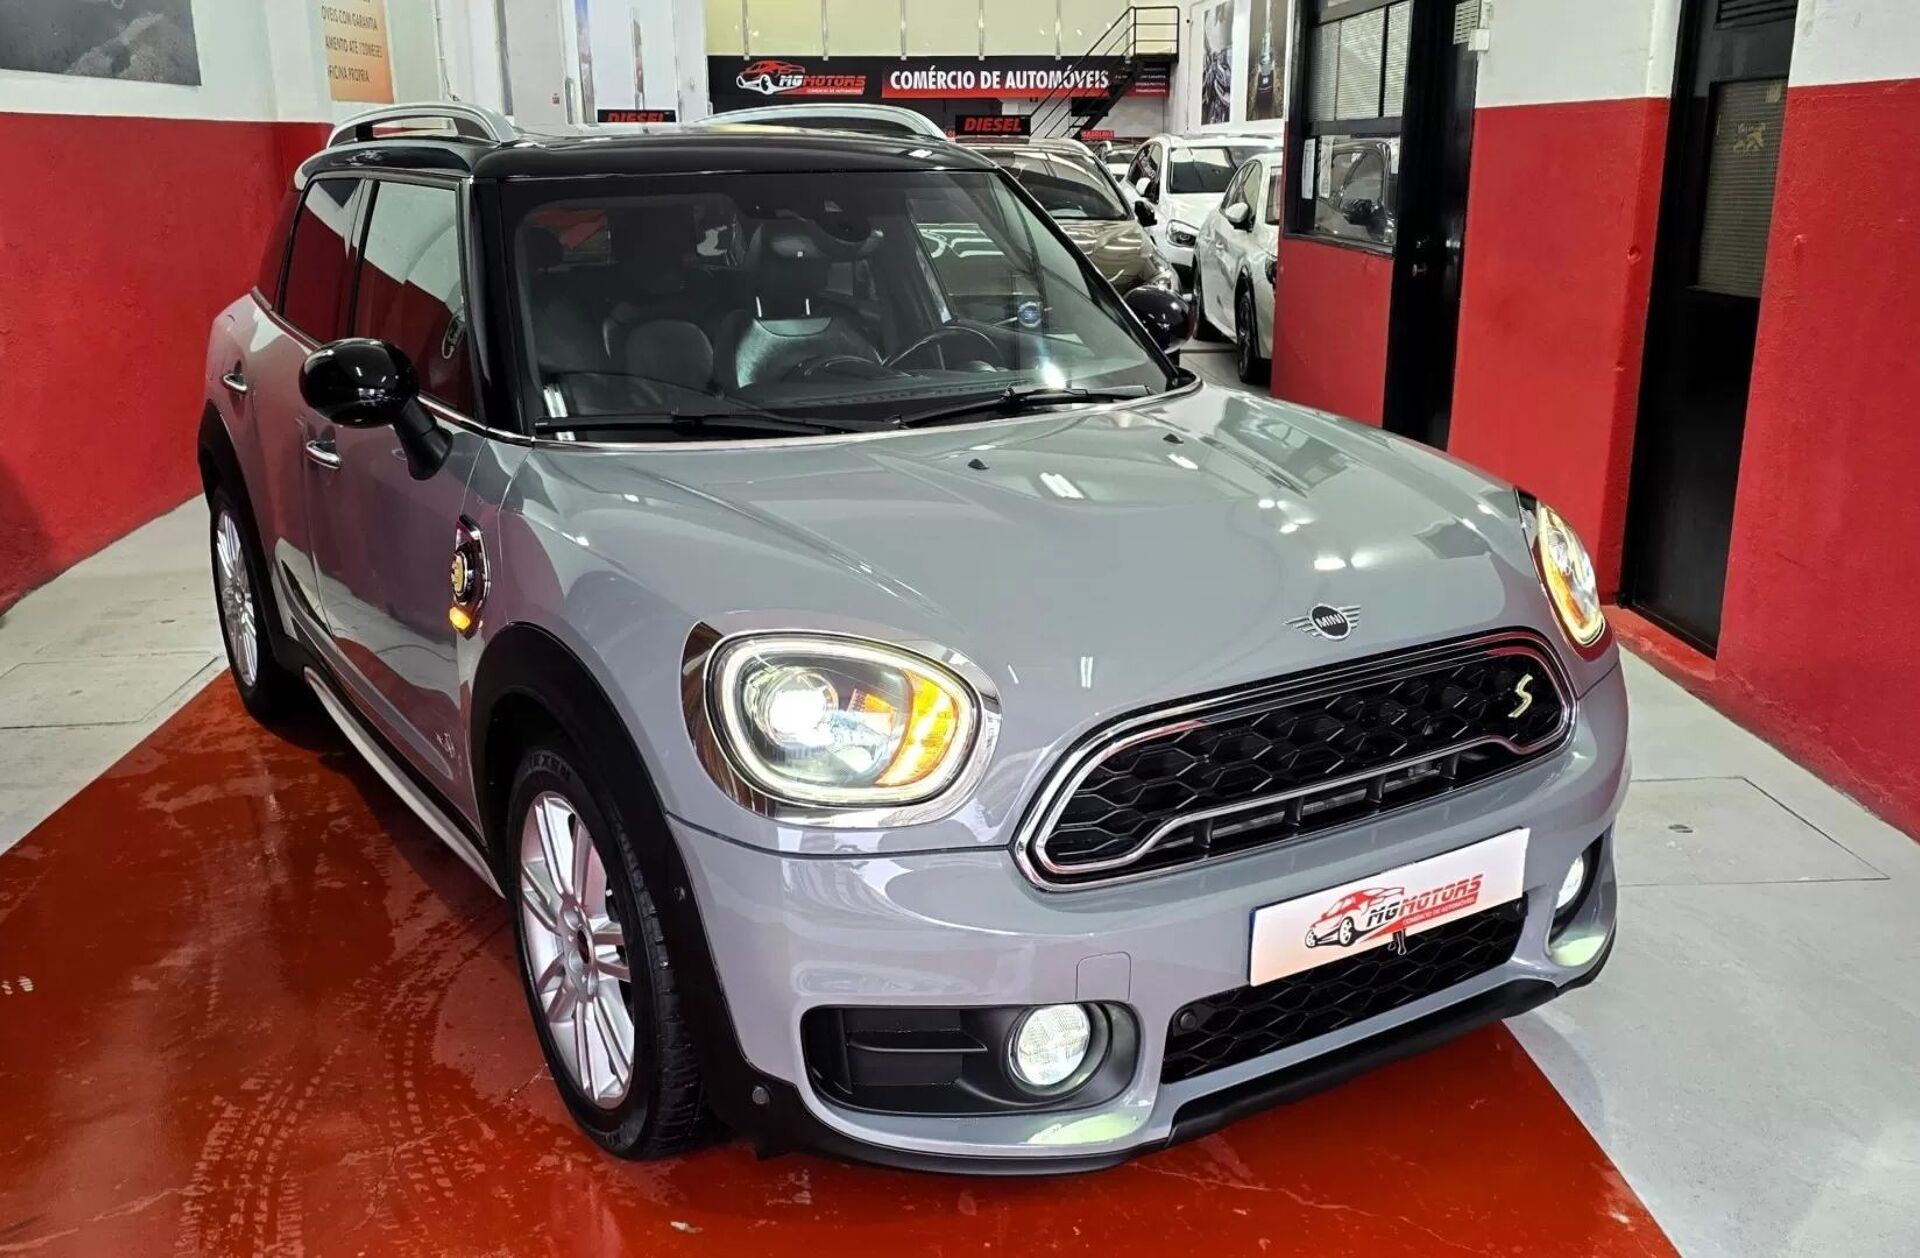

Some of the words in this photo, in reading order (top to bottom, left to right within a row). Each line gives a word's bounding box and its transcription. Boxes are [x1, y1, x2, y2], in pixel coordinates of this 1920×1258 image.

[890, 65, 975, 90] COMÉRCIO
[980, 70, 1000, 90] DE
[1004, 65, 1109, 90] AUTOMÓVEIS
[964, 117, 1022, 132] DIESEL
[1315, 613, 1345, 628] MINI
[1507, 673, 1534, 718] S
